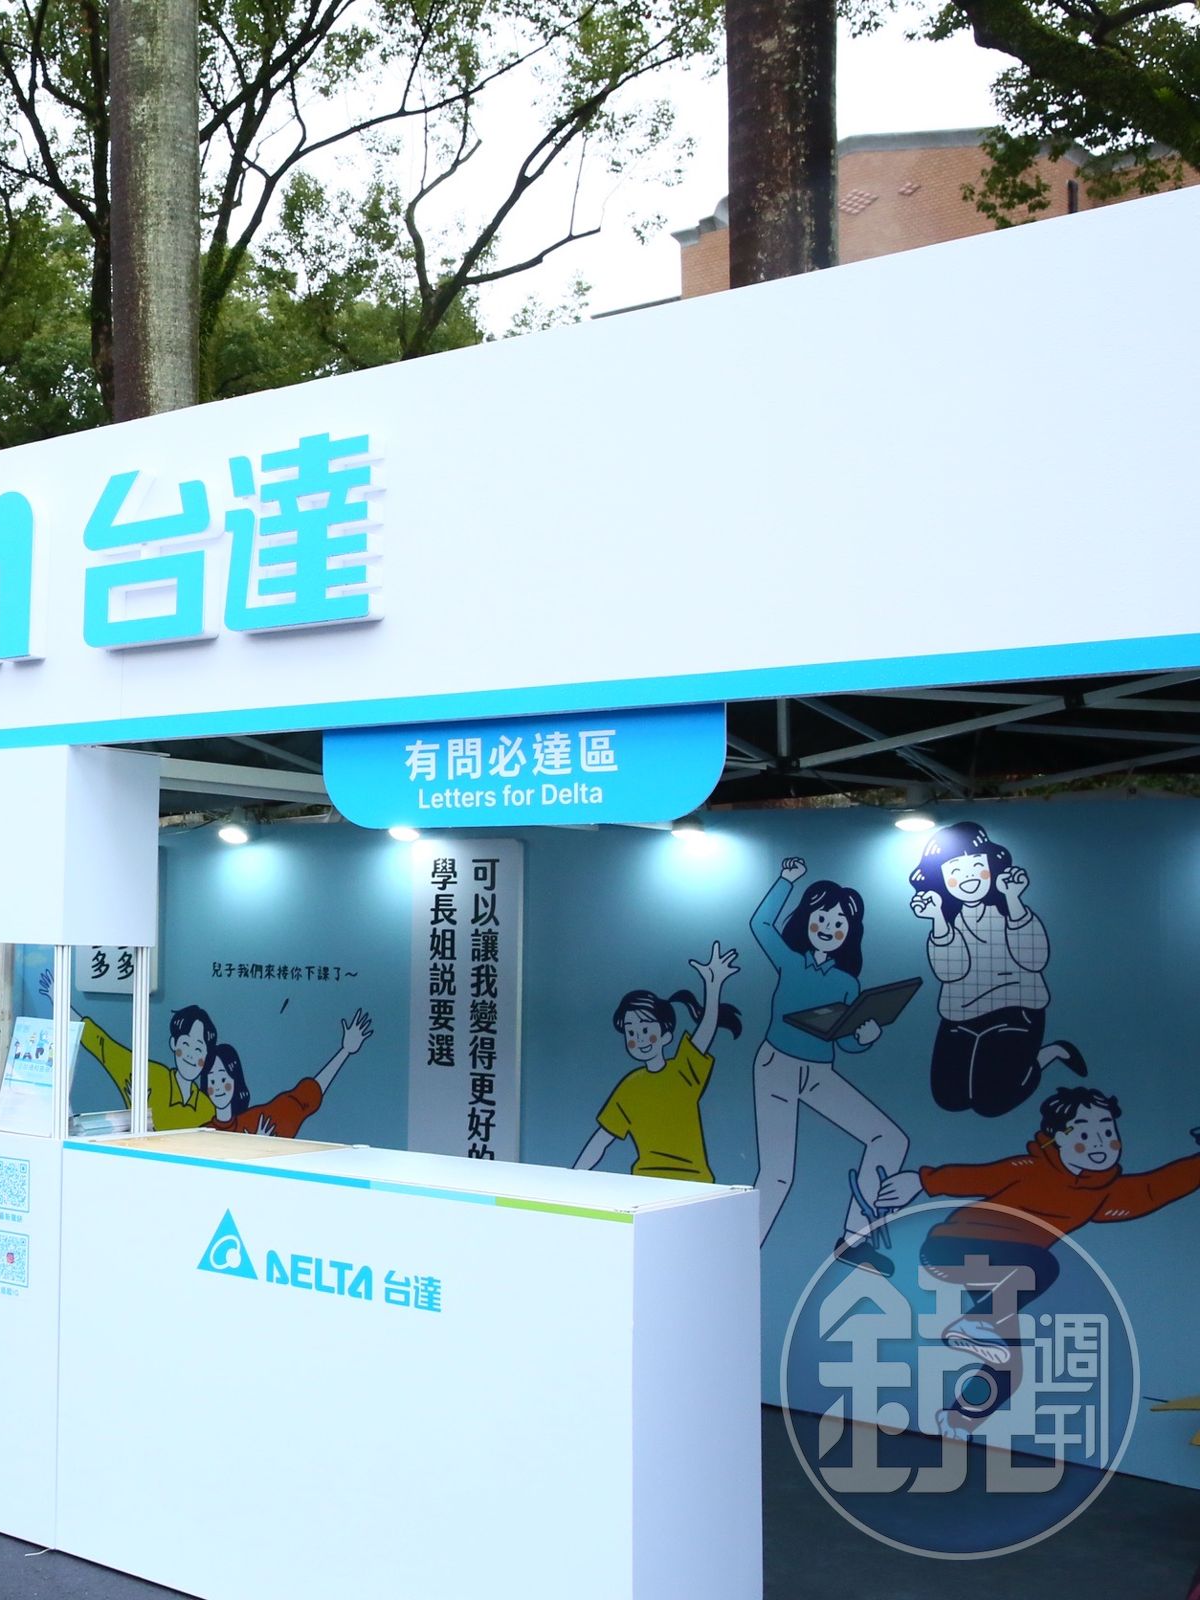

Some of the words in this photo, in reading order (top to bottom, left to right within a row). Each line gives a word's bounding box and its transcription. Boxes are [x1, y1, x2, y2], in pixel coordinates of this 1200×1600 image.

[83, 433, 377, 649] 台達
[405, 729, 618, 782] 有問必達區
[418, 787, 497, 809] Letters
[502, 784, 535, 807] for
[541, 782, 604, 805] Delta
[384, 1270, 442, 1313] 台達
